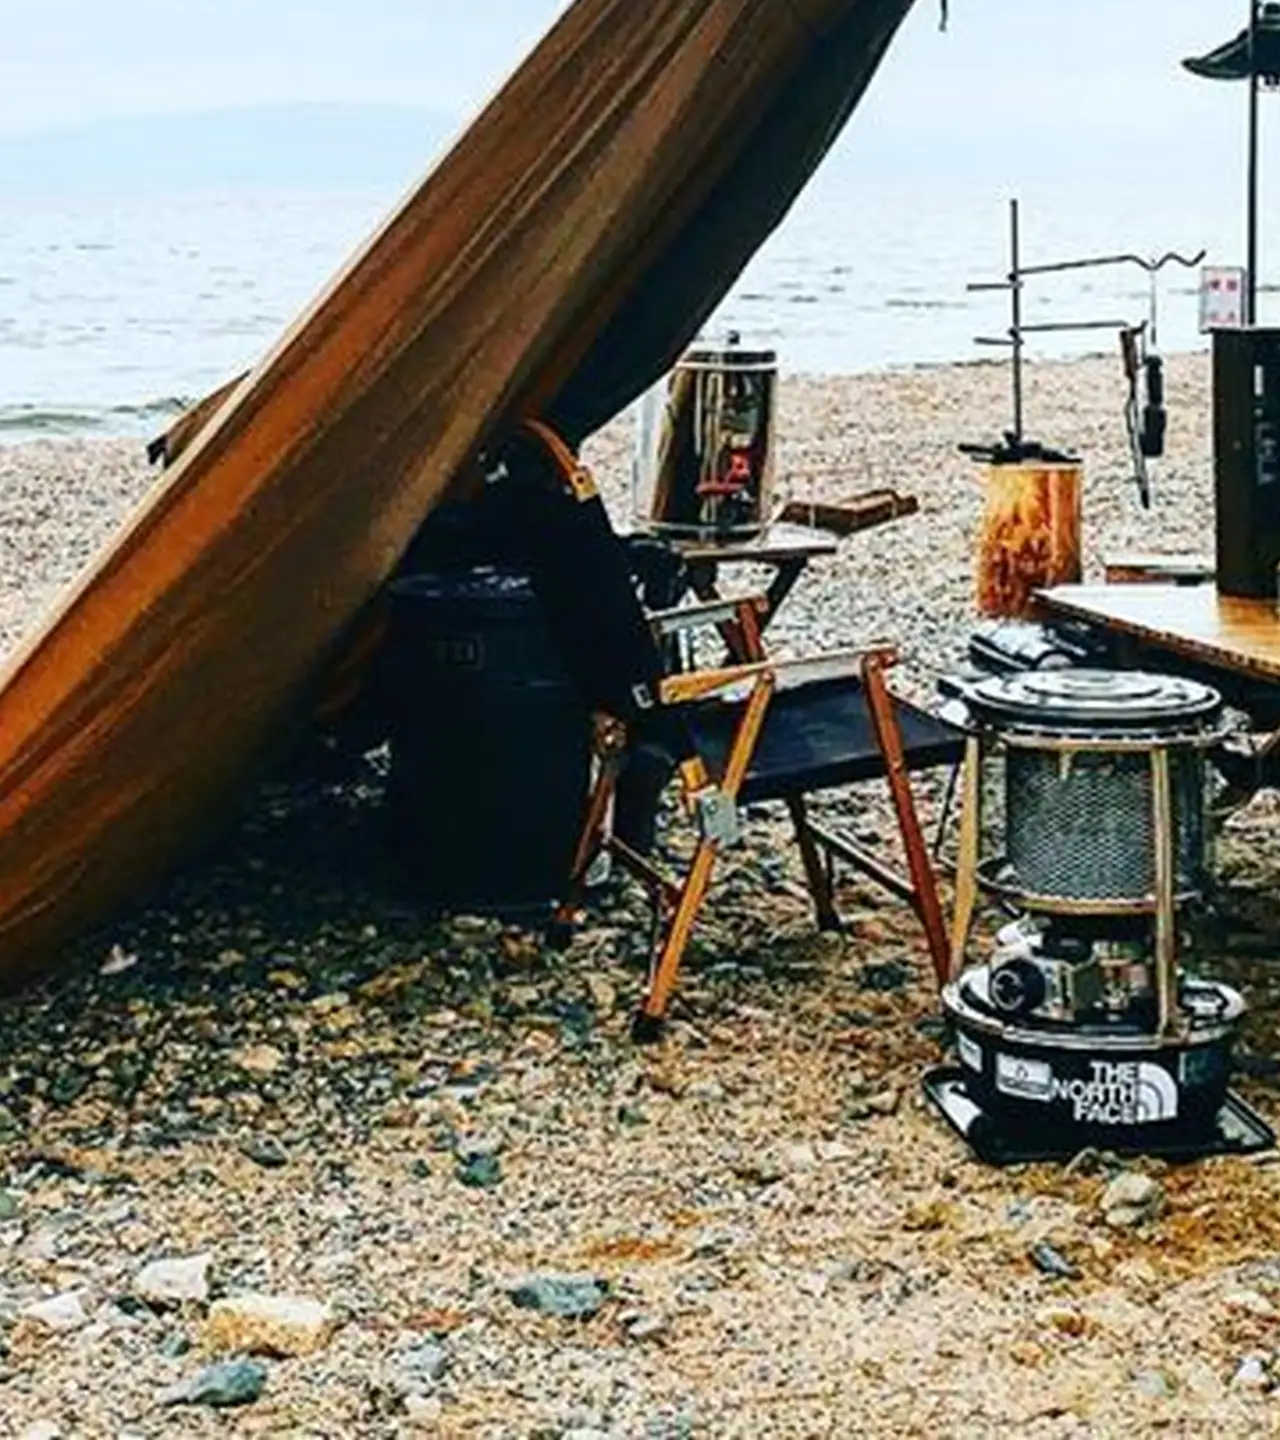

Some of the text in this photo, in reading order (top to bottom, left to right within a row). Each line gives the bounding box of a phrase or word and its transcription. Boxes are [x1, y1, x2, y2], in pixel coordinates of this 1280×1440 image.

[1090, 1061, 1137, 1084] THE
[1051, 1077, 1137, 1103] NORTH
[1073, 1099, 1135, 1124] FACE
